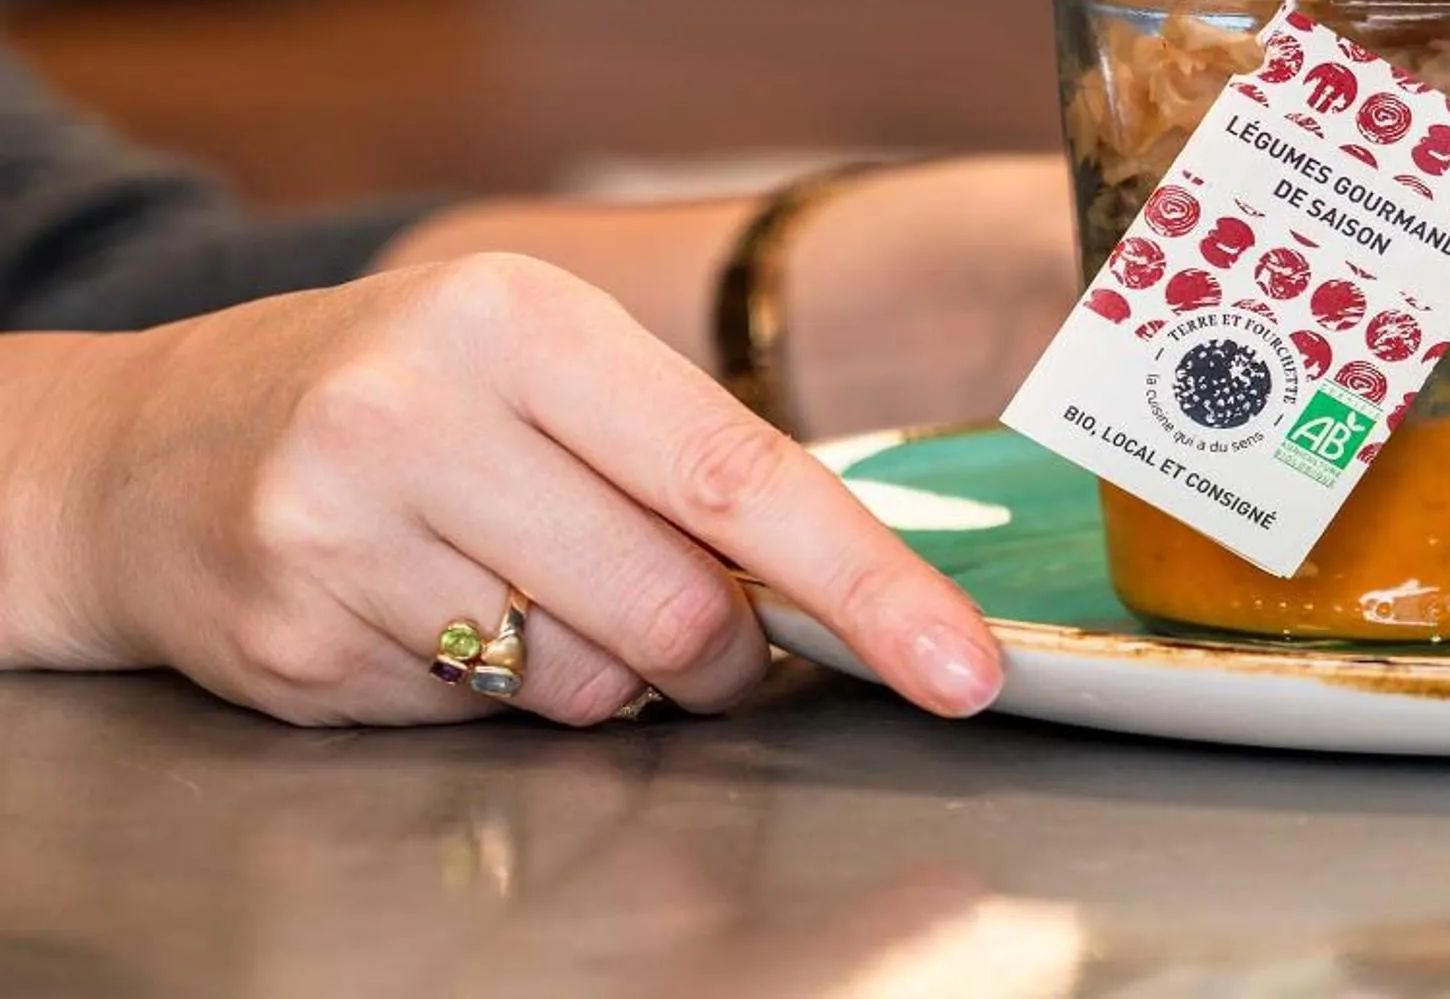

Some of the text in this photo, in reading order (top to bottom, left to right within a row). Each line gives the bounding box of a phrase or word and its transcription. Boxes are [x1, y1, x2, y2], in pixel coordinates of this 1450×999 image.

[1225, 115, 1333, 184] LÉGUMES
[1273, 178, 1392, 255] DE SAISON
[1167, 314, 1219, 342] TERRE
[1222, 314, 1242, 326] ET
[1244, 319, 1299, 405] FOURCHETTE
[1146, 374, 1265, 453] la cuisine qui a du sens
[1290, 415, 1352, 461] AB
[1063, 405, 1277, 530] BIO, LOCAL ET CONSIGNÉ
